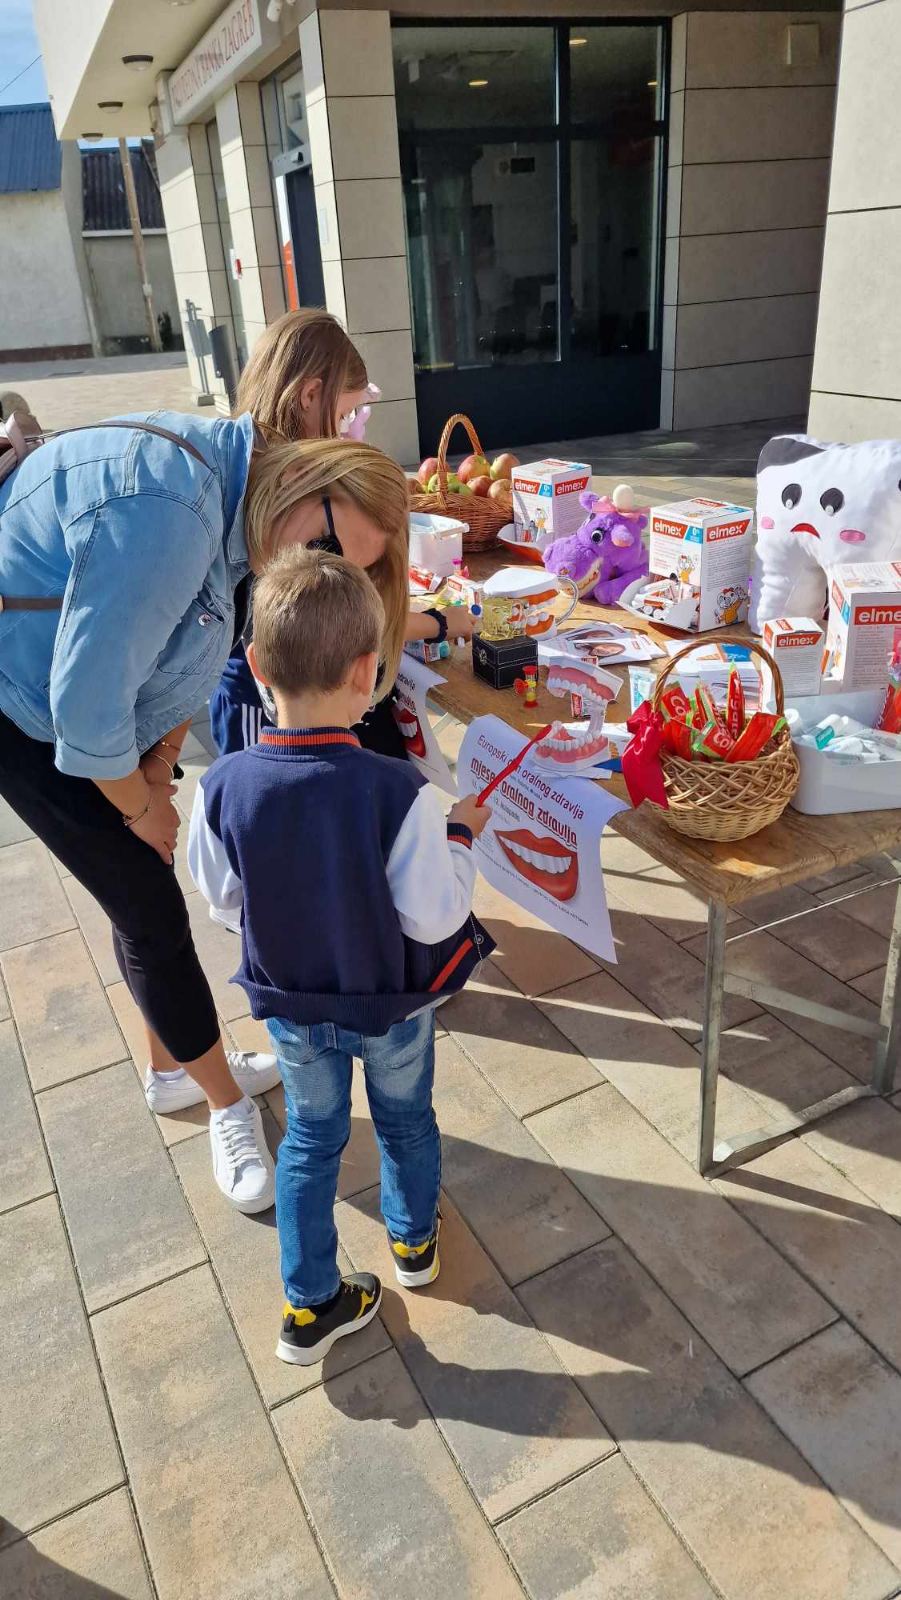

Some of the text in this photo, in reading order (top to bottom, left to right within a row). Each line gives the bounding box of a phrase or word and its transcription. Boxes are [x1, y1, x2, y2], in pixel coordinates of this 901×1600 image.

[515, 481, 537, 493] elmex
[557, 481, 583, 494] elmex
[654, 520, 682, 537] elmex
[709, 524, 743, 539] elmex
[778, 636, 814, 646] elmex
[477, 735, 508, 763] Europski
[521, 769, 551, 798] oralnog
[551, 791, 584, 820] zdravlja
[470, 757, 499, 786] mjese
[501, 781, 535, 818] oralnog
[537, 808, 577, 845] zdravlja
